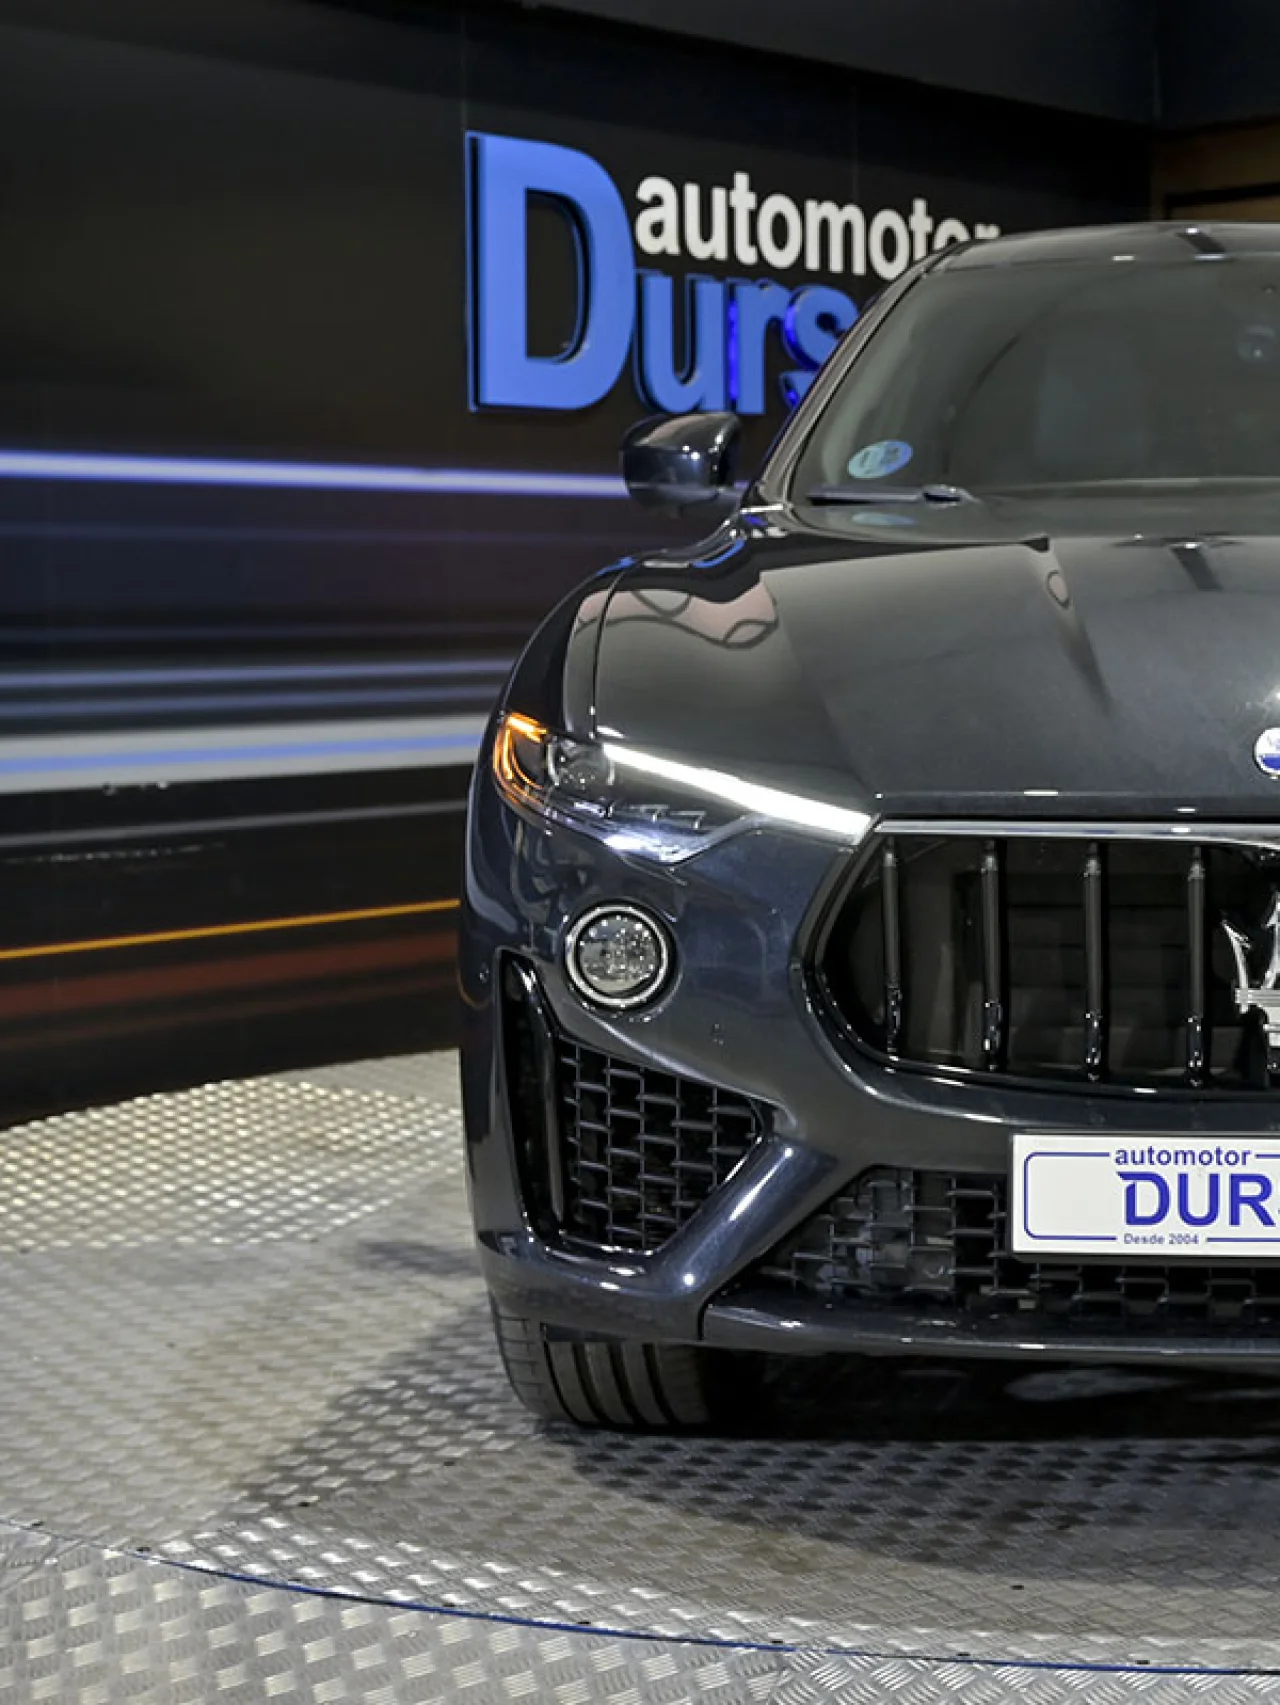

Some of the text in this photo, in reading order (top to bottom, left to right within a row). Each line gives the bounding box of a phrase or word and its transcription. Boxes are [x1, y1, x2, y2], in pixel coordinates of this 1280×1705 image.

[634, 171, 1000, 281] automot
[1115, 1146, 1252, 1166] automotor
[1124, 1233, 1199, 1245] Desde 2004
